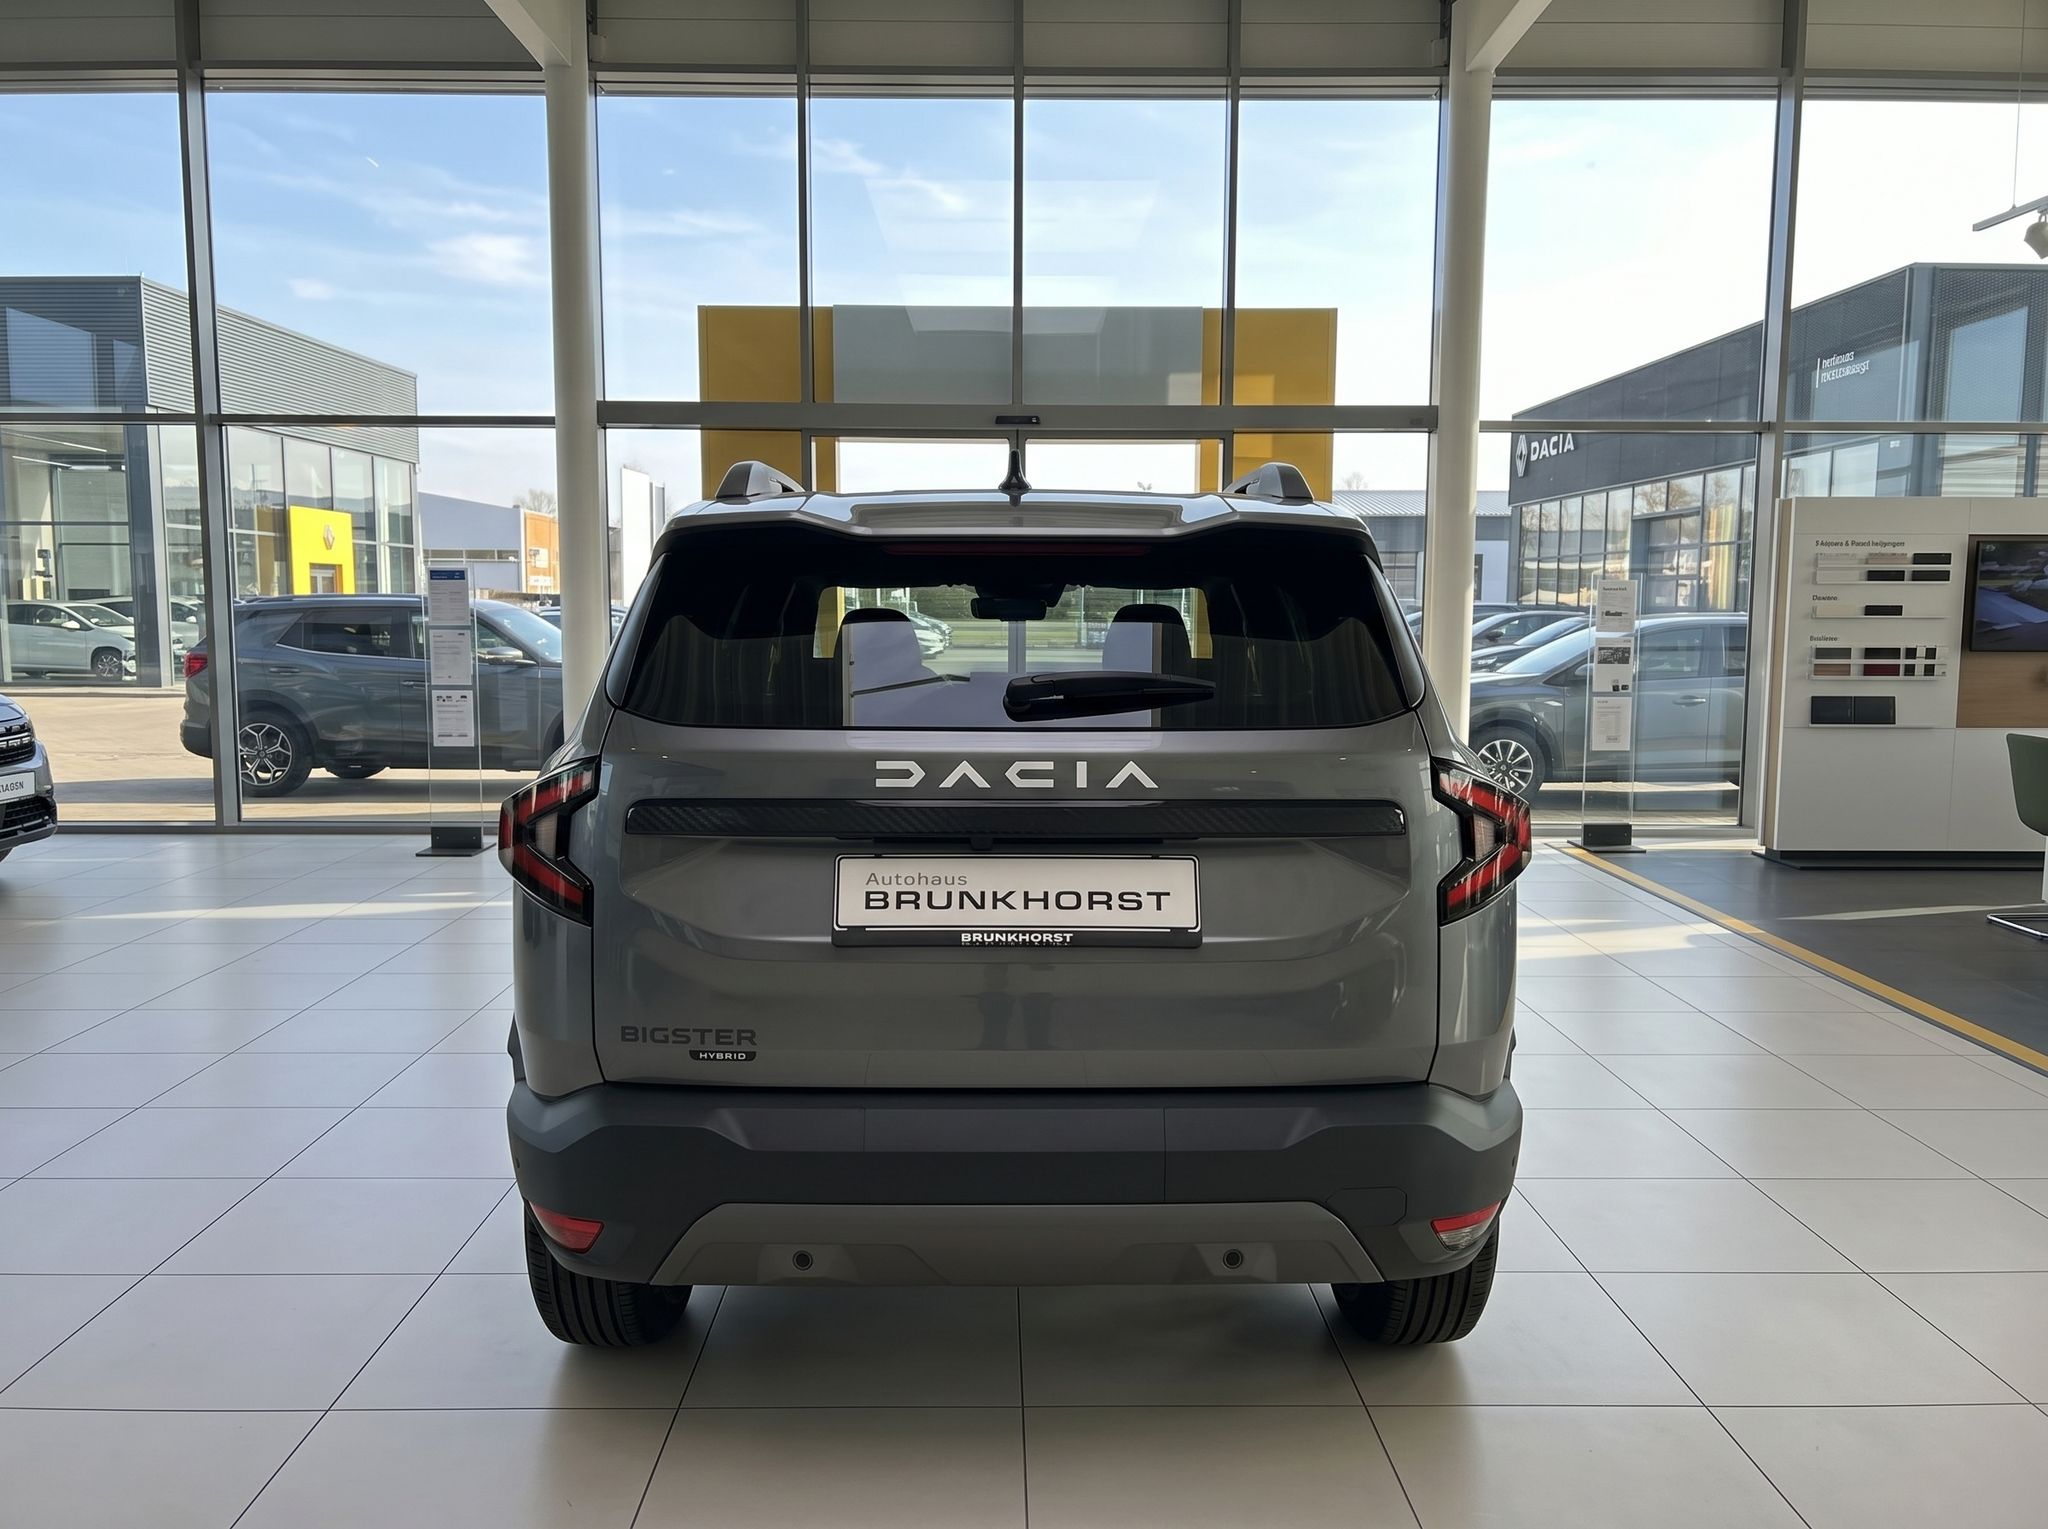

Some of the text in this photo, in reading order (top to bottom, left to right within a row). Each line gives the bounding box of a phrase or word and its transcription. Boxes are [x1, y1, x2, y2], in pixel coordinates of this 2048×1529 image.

[1530, 433, 1575, 461] DACIA
[875, 760, 1159, 788] DACIA
[865, 872, 968, 886] Autohaus
[864, 890, 1171, 911] BRUNKHORST
[961, 932, 1074, 943] BRUNKHORST
[620, 1026, 757, 1046] BIGSTER
[699, 1052, 746, 1060] HYBRID
